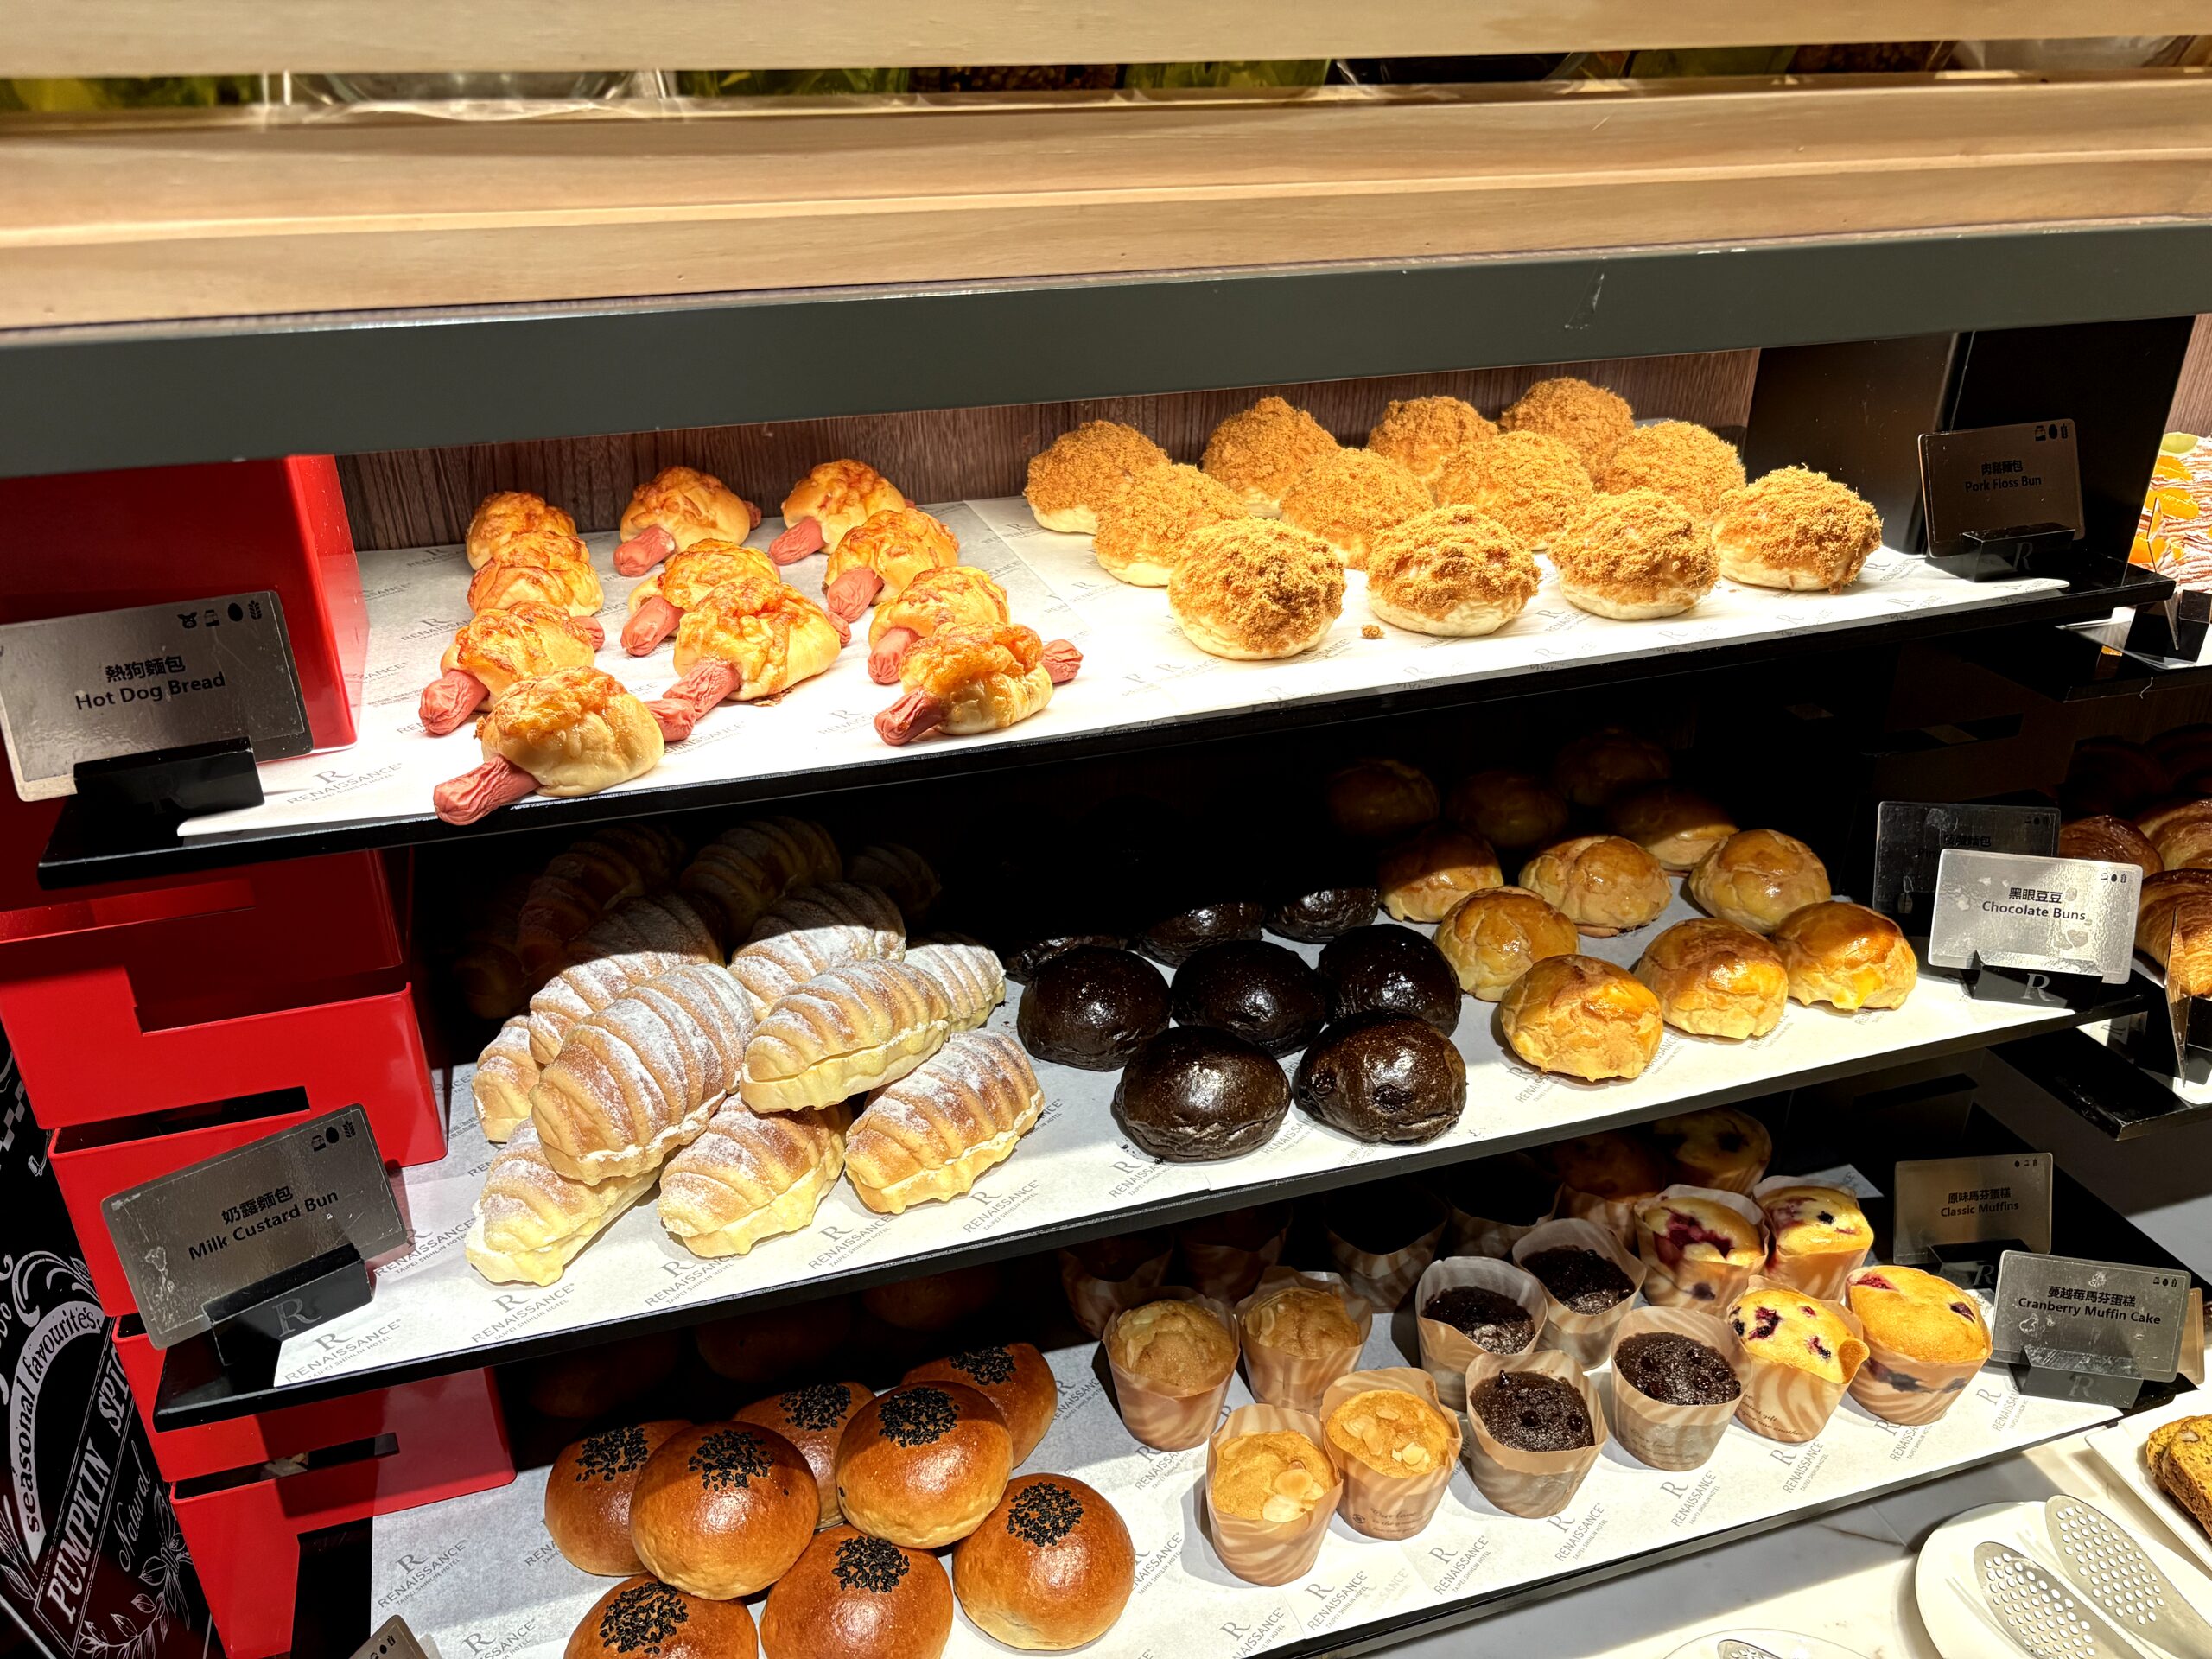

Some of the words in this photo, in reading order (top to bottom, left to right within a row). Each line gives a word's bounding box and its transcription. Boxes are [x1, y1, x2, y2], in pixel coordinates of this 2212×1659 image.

[1965, 479, 1990, 493] Pork
[1993, 477, 2019, 489] Floss
[2021, 475, 2042, 487] Bun
[105, 655, 186, 683] 熱狗麵包
[75, 691, 116, 710] Hot
[119, 684, 163, 704] Dog
[168, 671, 226, 696] Bread
[664, 723, 742, 754] ENAISSANCE
[286, 764, 398, 804] RENAISSANCE
[312, 770, 354, 785] R
[2008, 887, 2063, 904] 黑眼豆豆
[1982, 900, 2049, 918] Chocolate
[2052, 906, 2087, 921] Buns
[2020, 973, 2056, 1002] R
[1507, 1066, 1537, 1082] R
[1110, 1161, 1142, 1176] R
[220, 1185, 294, 1225] 奶露麵包
[969, 1191, 1003, 1205] R
[1948, 1186, 2012, 1204] 原味馬芬蛋糕
[963, 1183, 1039, 1234] RENAISSANCE
[1940, 1205, 1976, 1218] Classic
[1978, 1201, 2019, 1214] Muffins
[188, 1236, 228, 1260] Milk
[232, 1204, 301, 1242] Custard
[304, 1192, 339, 1212] Bun
[819, 1224, 855, 1242] R
[374, 1219, 474, 1277] RENAISSANCE
[808, 1215, 890, 1270] RENAISSANCE
[659, 1261, 696, 1278] R
[471, 1285, 571, 1343] RENAISSANCE
[492, 1294, 531, 1313] R
[2018, 1297, 2081, 1317] Cranberry
[2084, 1305, 2127, 1321] Muffin
[2130, 1311, 2162, 1325] Cake
[272, 1298, 322, 1338] R
[284, 1321, 397, 1382] RENAISSANCE
[312, 1332, 353, 1352] R
[1975, 1389, 2002, 1406] R
[2068, 1375, 2095, 1397] R
[1874, 1419, 1902, 1436] R
[16, 1375, 41, 1534] seasonal
[1135, 1446, 1162, 1462] R
[1770, 1449, 1797, 1467] R
[1783, 1440, 1824, 1494] RENAISSANCE
[1660, 1481, 1688, 1500] R
[1671, 1472, 1717, 1528] RENAISSANCE
[118, 1440, 152, 1572] Natural
[48, 1436, 111, 1625] PUMPKIN
[1548, 1515, 1576, 1534] R
[1555, 1506, 1605, 1561] RENAISSANCE
[395, 1554, 429, 1574] R
[1133, 1535, 1183, 1587] NAISSANCE
[1427, 1547, 1459, 1565] R
[1433, 1538, 1489, 1595] RENAISSANCE
[378, 1541, 467, 1609] RENAISSANCE
[1304, 1583, 1336, 1601] R
[1307, 1573, 1368, 1631] RENAISSANCE
[461, 1632, 497, 1656] R
[1219, 1621, 1251, 1641] R
[1233, 1610, 1285, 1659] NAISSANCE
